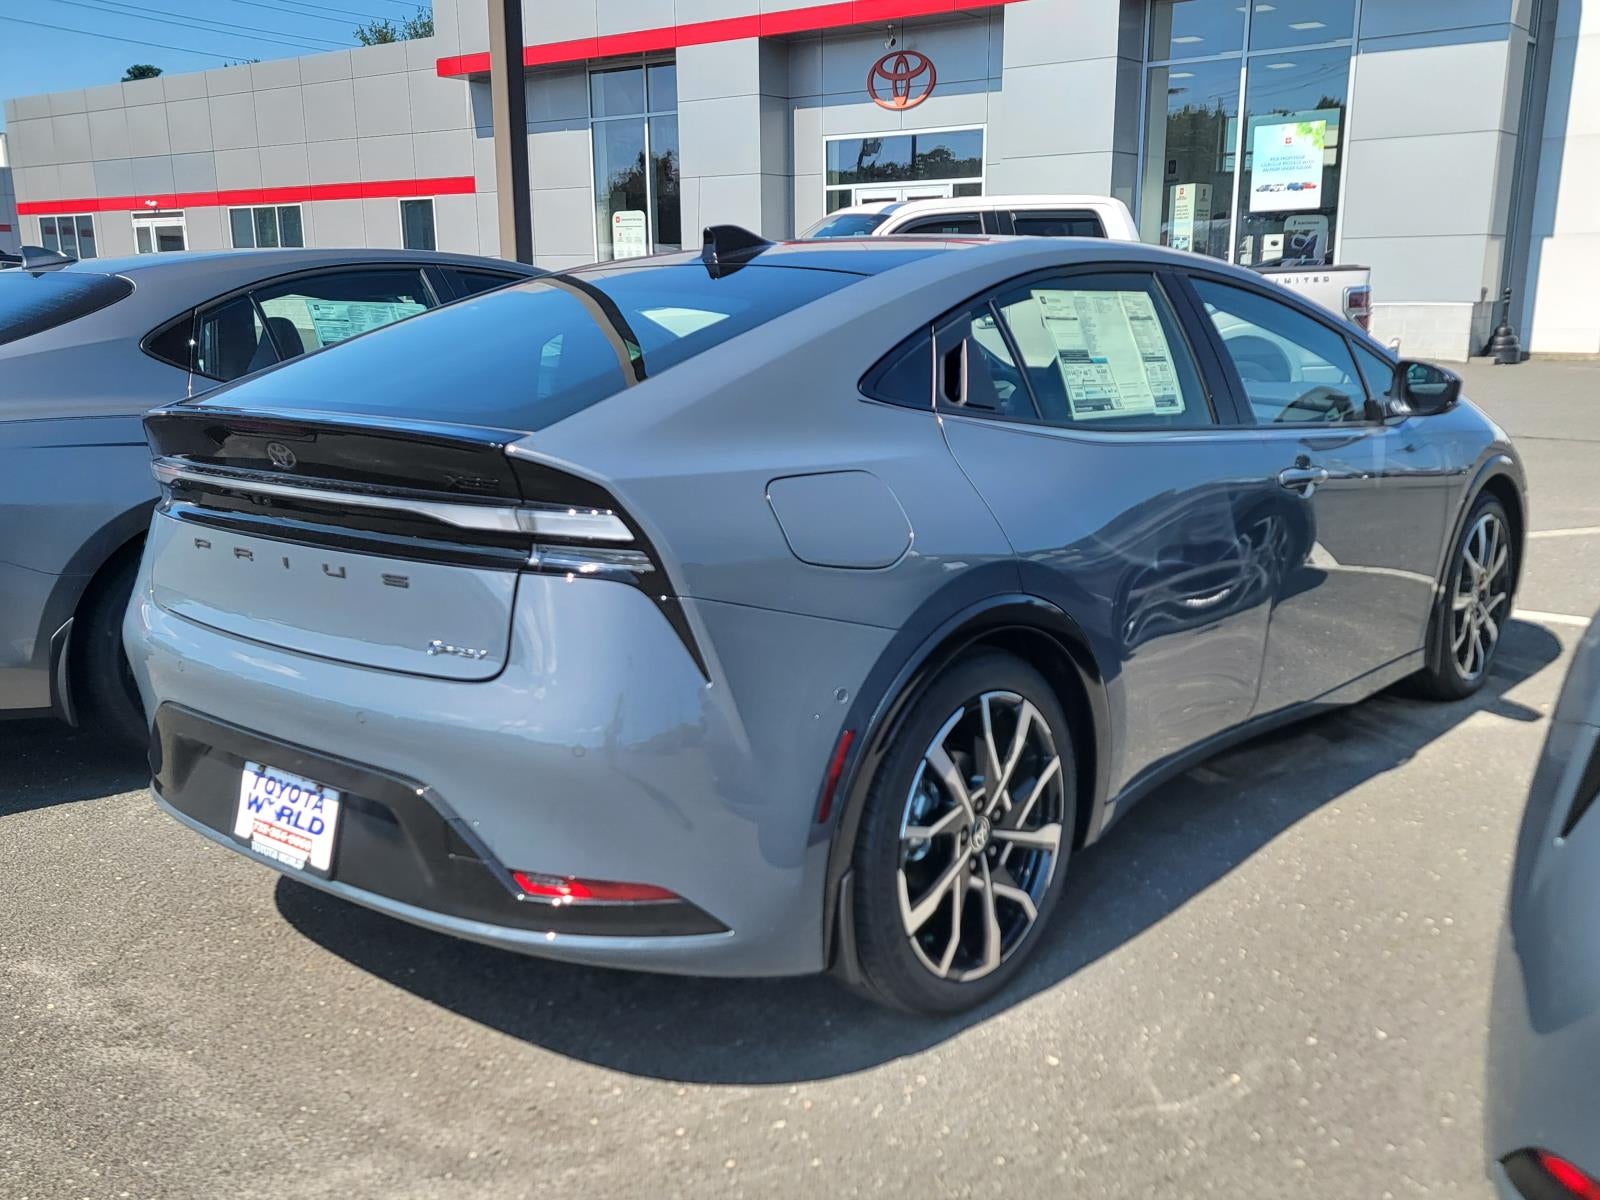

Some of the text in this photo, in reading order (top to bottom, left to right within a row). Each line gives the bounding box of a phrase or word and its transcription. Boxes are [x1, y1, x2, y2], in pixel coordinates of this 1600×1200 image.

[1274, 276, 1330, 286] IMITED
[194, 537, 410, 589] PRIUS
[252, 770, 326, 814] TOYOTA
